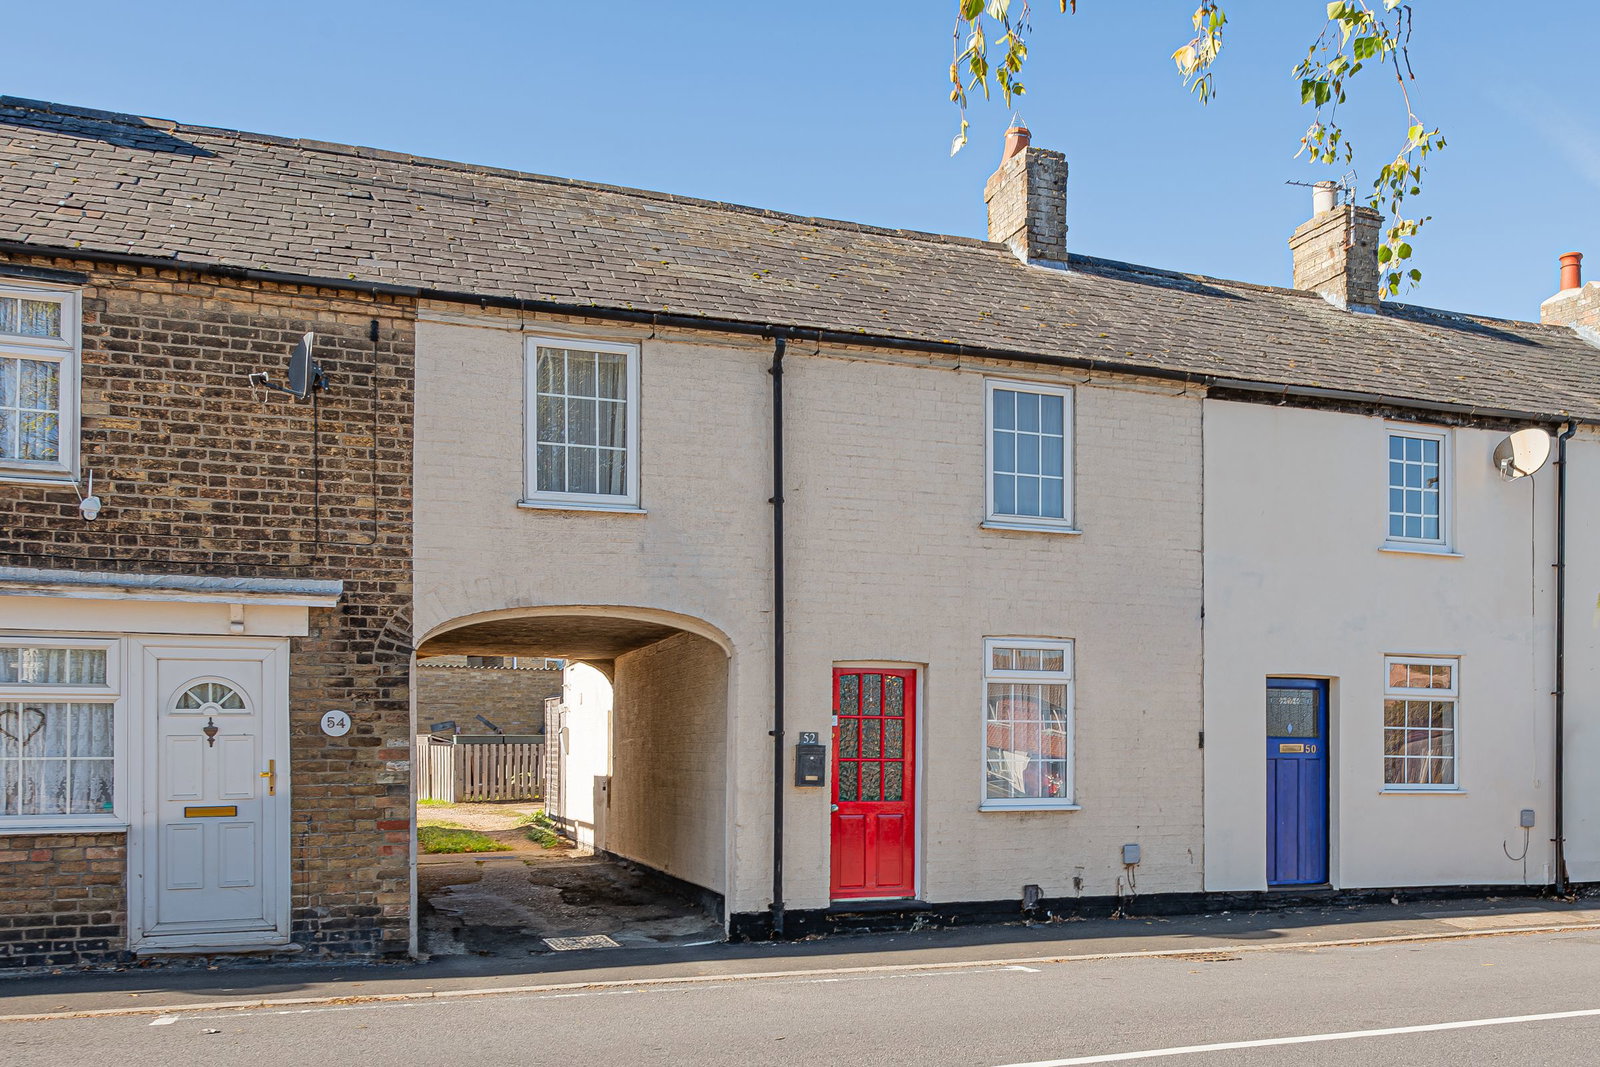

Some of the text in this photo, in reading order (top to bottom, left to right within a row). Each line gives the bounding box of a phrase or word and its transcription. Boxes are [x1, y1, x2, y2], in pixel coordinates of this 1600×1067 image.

[327, 717, 345, 728] 54
[803, 733, 816, 744] 52
[1305, 744, 1317, 753] 50
